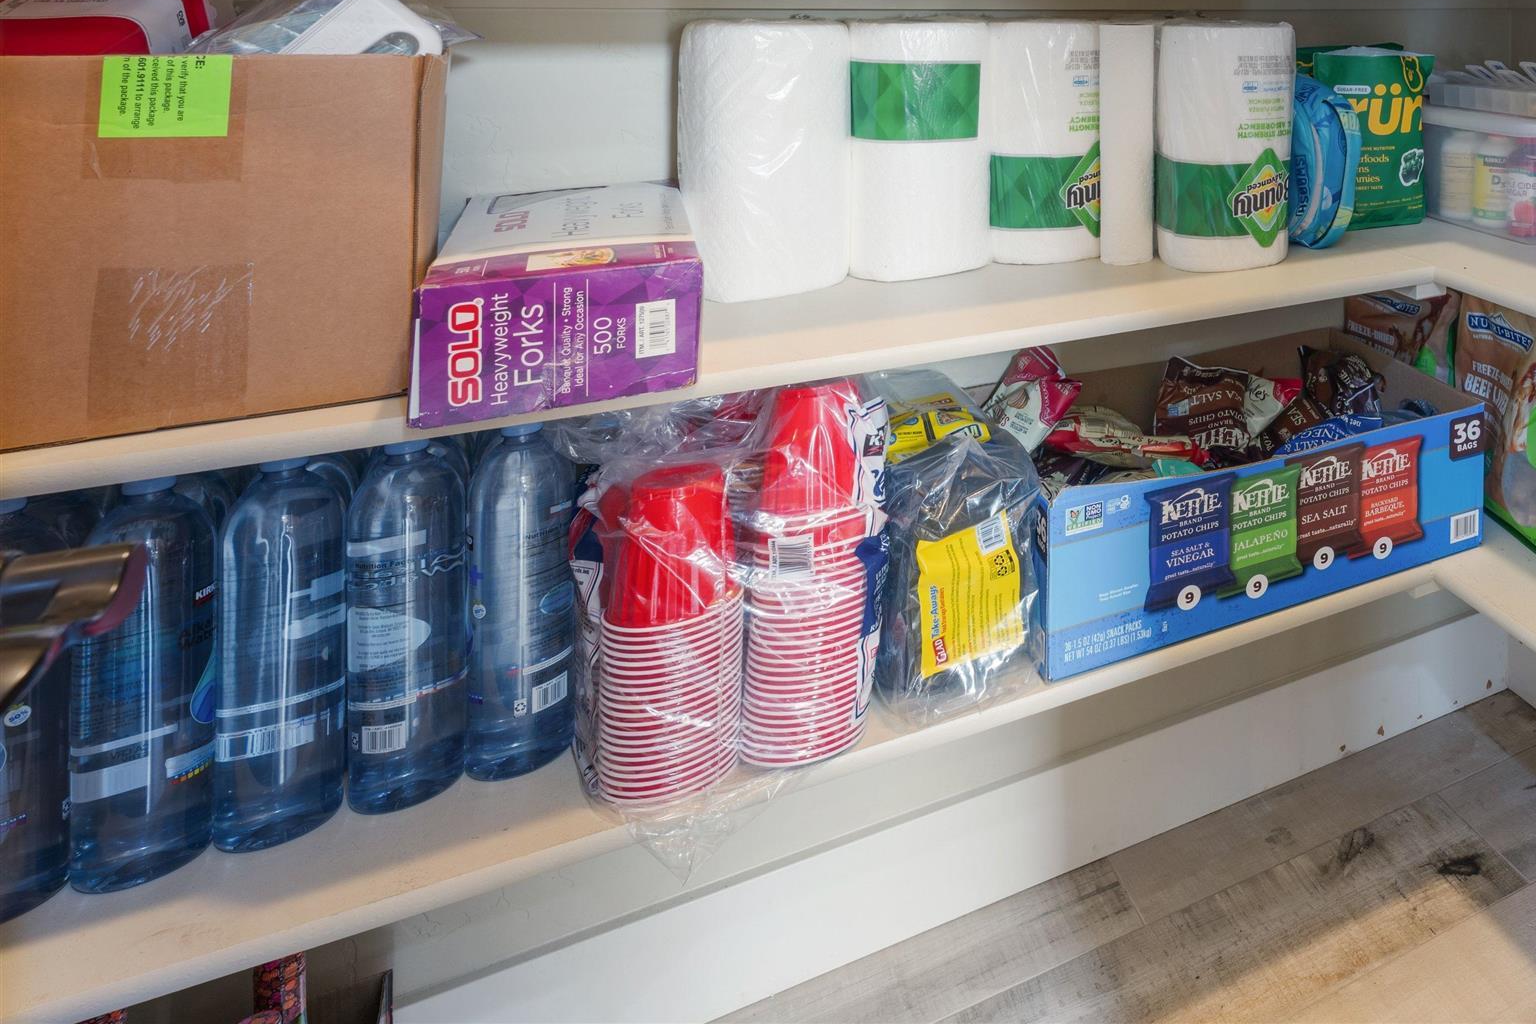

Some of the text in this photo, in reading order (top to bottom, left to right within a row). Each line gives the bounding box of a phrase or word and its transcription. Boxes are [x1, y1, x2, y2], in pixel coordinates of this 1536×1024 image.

[122, 73, 130, 84] the
[166, 68, 174, 81] this
[178, 60, 189, 79] verify
[146, 83, 159, 126] this package
[177, 96, 186, 109] you
[1348, 84, 1424, 136] rün
[131, 102, 141, 129] arrange
[561, 287, 572, 394] Banquet Quality Strong
[575, 291, 585, 387] Ideal for Any Occasion
[594, 317, 612, 354] 500
[617, 318, 626, 349] FORKS
[449, 302, 483, 406] SOLO
[490, 292, 509, 406] Heavyweight
[513, 304, 545, 386] Forks
[1454, 420, 1481, 444] 36
[1457, 441, 1477, 452] BAGS
[1298, 456, 1352, 491] KETTLE
[1360, 448, 1411, 481] KETTLE
[1315, 482, 1335, 493] BRAND
[1361, 479, 1409, 497] POTATO CHIPS
[1376, 474, 1395, 484] BRAND
[1231, 479, 1289, 515] KETTLE
[1300, 487, 1350, 505] POTATO CHIPS
[1085, 507, 1101, 516] GMO
[1086, 502, 1101, 512] NON
[1160, 488, 1222, 525] KETTLE
[1249, 507, 1271, 517] BRAND
[1301, 504, 1348, 525] SEA SALT
[1179, 516, 1203, 527] BRAND
[1233, 511, 1287, 531] POTATO CHIPS
[1162, 521, 1219, 542] POTATO CHIPS
[1166, 548, 1215, 568] VINEGAR
[1171, 546, 1185, 557] SEA
[1186, 543, 1203, 553] SALT
[1320, 553, 1328, 564] 9
[1380, 543, 1387, 554] 9
[1253, 581, 1262, 592] 9
[1185, 591, 1194, 604] 9
[935, 640, 947, 665] GLAD
